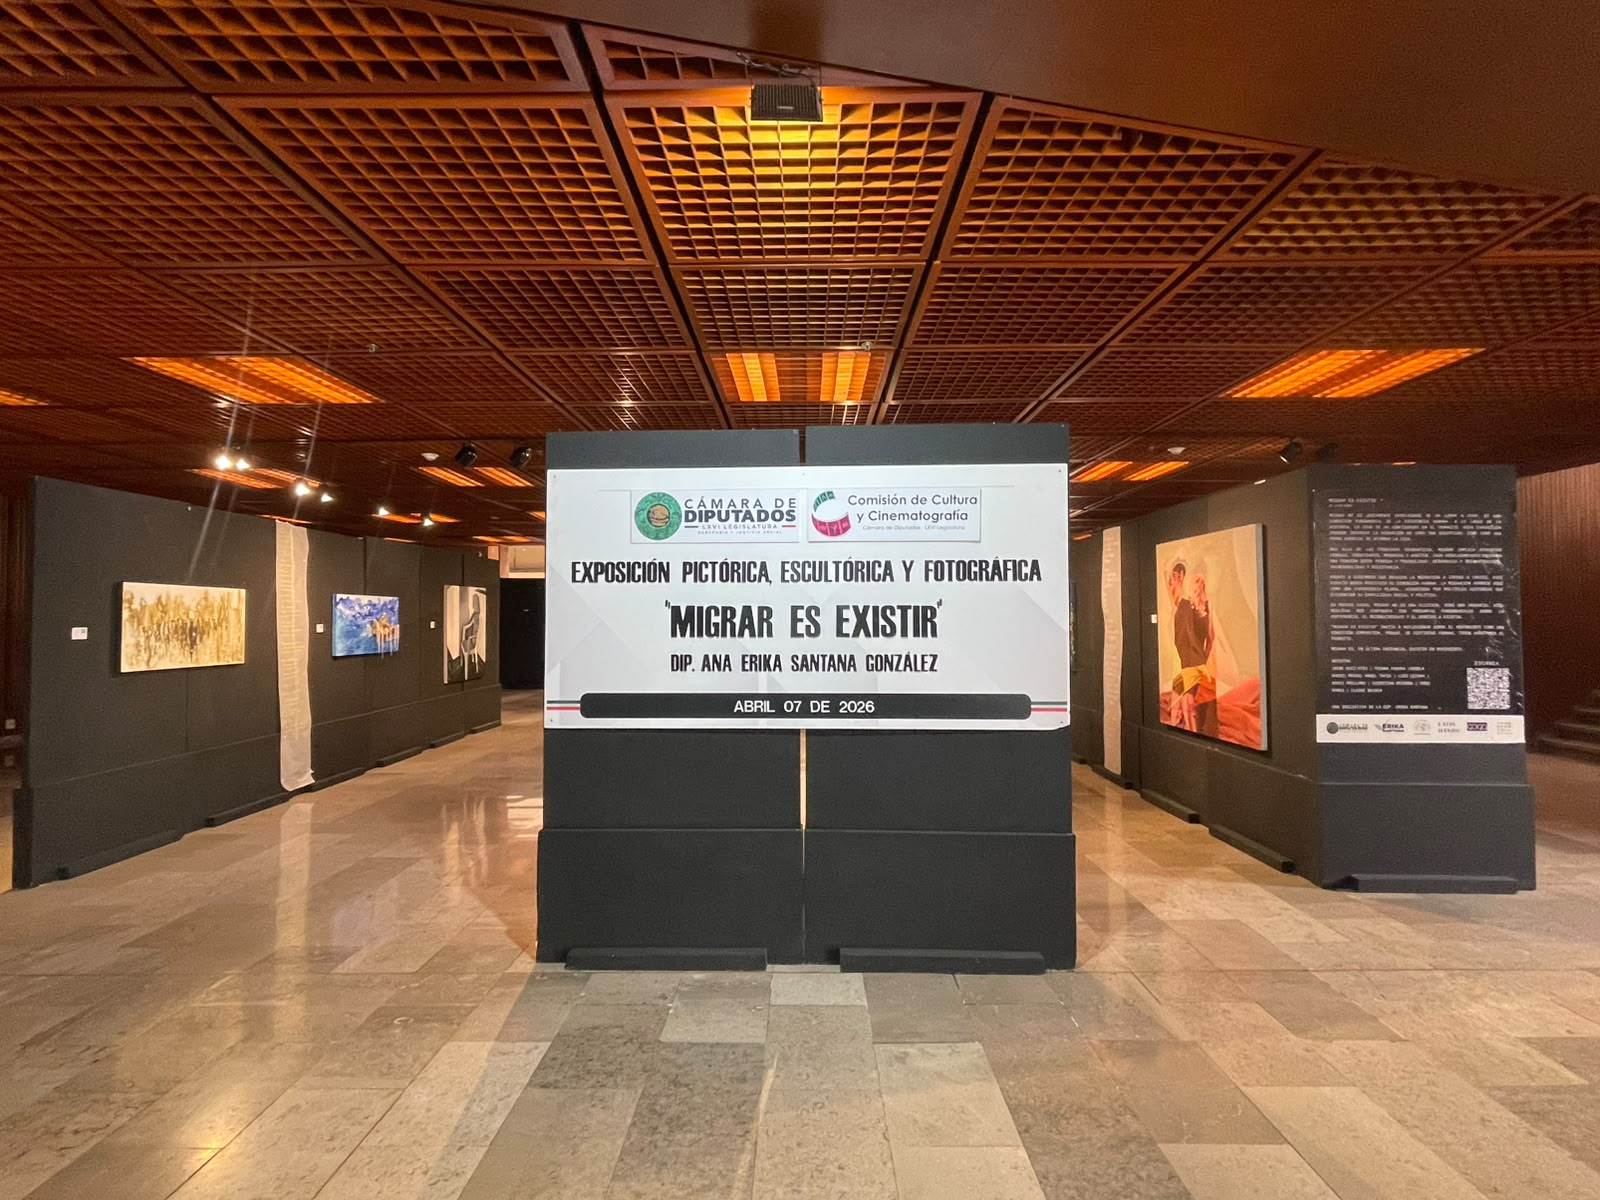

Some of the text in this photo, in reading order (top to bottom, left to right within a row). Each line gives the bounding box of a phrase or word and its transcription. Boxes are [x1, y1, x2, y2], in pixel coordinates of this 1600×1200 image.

[684, 496, 796, 509] CÁMARA DE
[848, 493, 978, 505] Comisión de Cultura
[684, 509, 796, 523] DIPUTADOS
[857, 508, 968, 523] y Cinematografía
[571, 557, 1042, 585] EXPOSICIÓN PICTÓRICA, ESCULTÓRICA Y FOTOGRÁFICA
[665, 599, 942, 638] "MIGRAR ES EXISTIR"
[671, 652, 938, 673] DIP. ANA ERIKA SANTANA GONZÁLEZ
[733, 700, 876, 714] ABRIL 07 DE 2026
